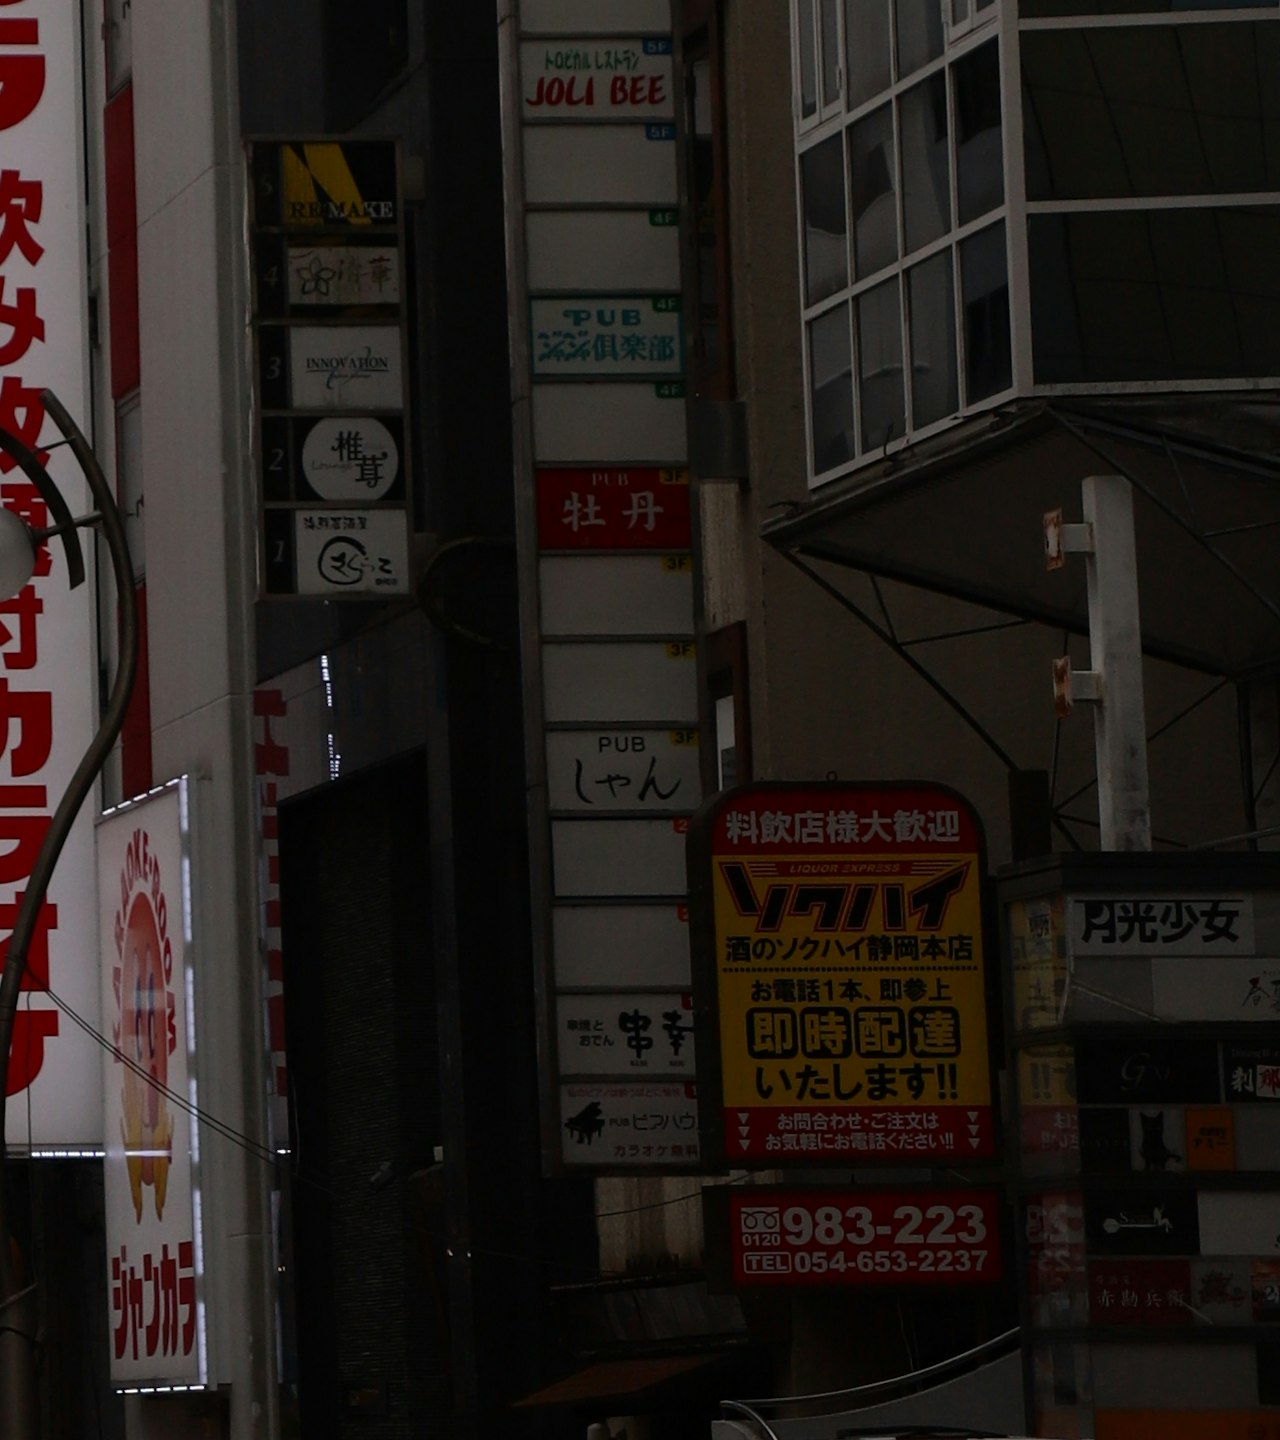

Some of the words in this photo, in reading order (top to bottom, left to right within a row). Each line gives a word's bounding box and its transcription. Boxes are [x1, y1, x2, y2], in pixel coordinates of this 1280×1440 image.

[647, 40, 669, 53] 5F
[525, 75, 594, 106] JOLI
[610, 74, 666, 105] BEE
[650, 125, 672, 138] 5F
[653, 211, 674, 224] 4F
[656, 298, 679, 310] 4F
[562, 308, 642, 327] PUB
[305, 354, 389, 371] INNOVATION
[658, 384, 681, 396] 4F
[267, 449, 284, 470] 2
[591, 471, 629, 487] PUB
[663, 469, 685, 482] 3F
[560, 489, 665, 534] 牡丹
[272, 539, 286, 563] 1
[666, 556, 688, 569] 3F
[670, 643, 692, 656] 3F
[598, 735, 646, 753] PUB
[675, 731, 696, 744] 3F
[575, 755, 682, 804] しゃん
[725, 809, 961, 846] 料飲店様大歓迎
[788, 862, 840, 875] LIQUOR
[842, 862, 901, 875] EXPRESS
[719, 862, 968, 933] ソクハイ
[1081, 900, 1241, 945] 月光少女
[725, 933, 974, 962] 酒のソクハイ静岡本店
[750, 977, 953, 1003] お電話1本、即参上
[578, 1034, 615, 1047] おでん
[747, 1006, 961, 1059] 即時配達
[754, 1063, 958, 1102] いたします!!
[776, 1111, 940, 1131] お問合わせ・ご注文は
[782, 1205, 989, 1247] 983-223
[741, 1233, 782, 1247] 0120
[747, 1254, 790, 1273] TEL
[793, 1249, 989, 1274] 054-653-2237
[111, 1239, 198, 1362] ジャンカラ
